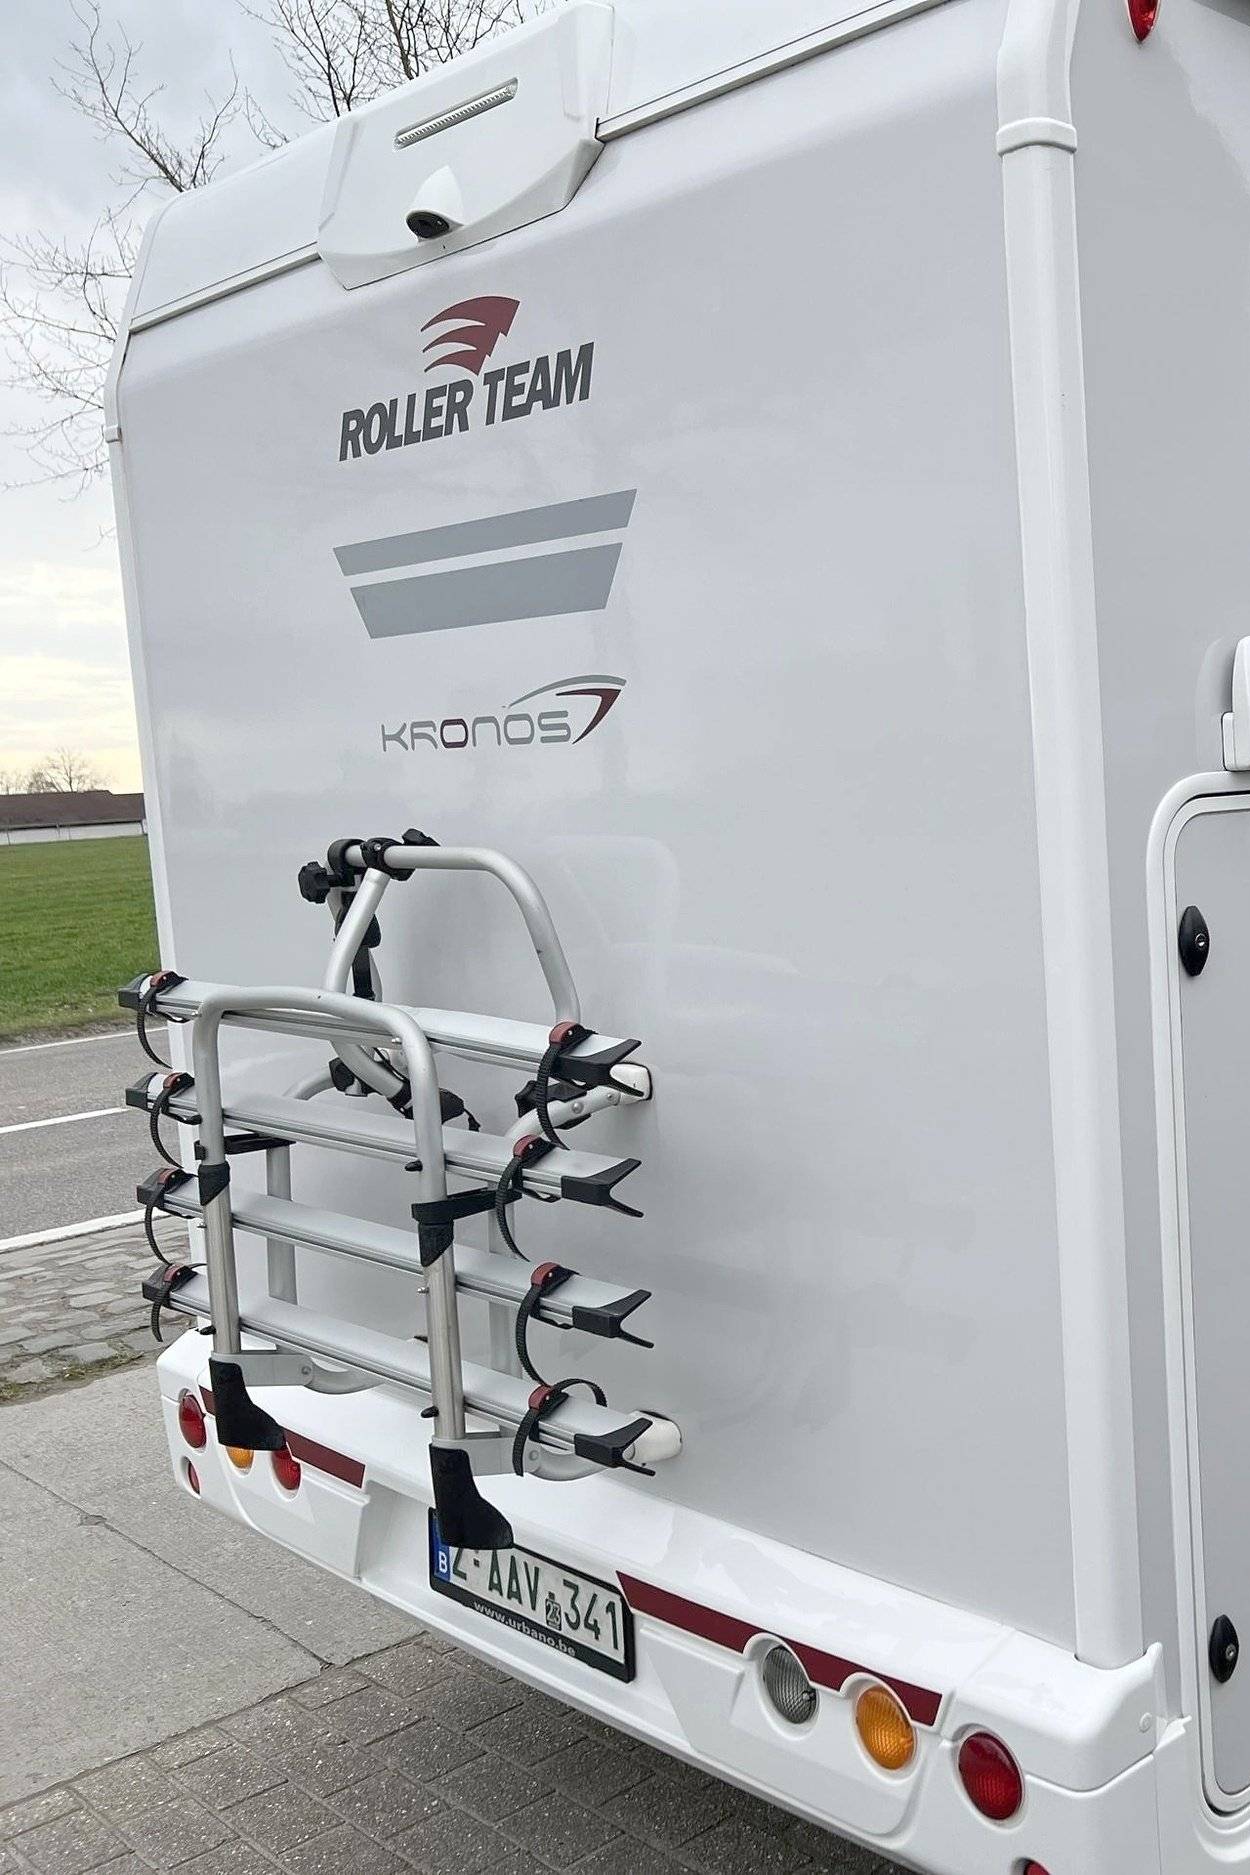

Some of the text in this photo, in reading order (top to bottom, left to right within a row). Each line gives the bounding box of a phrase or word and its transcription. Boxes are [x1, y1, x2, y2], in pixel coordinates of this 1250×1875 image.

[339, 341, 594, 462] ROLLER TEAM
[381, 709, 572, 752] KRONOS
[438, 1552, 448, 1574] B
[474, 1600, 576, 1657] www.urbano.be
